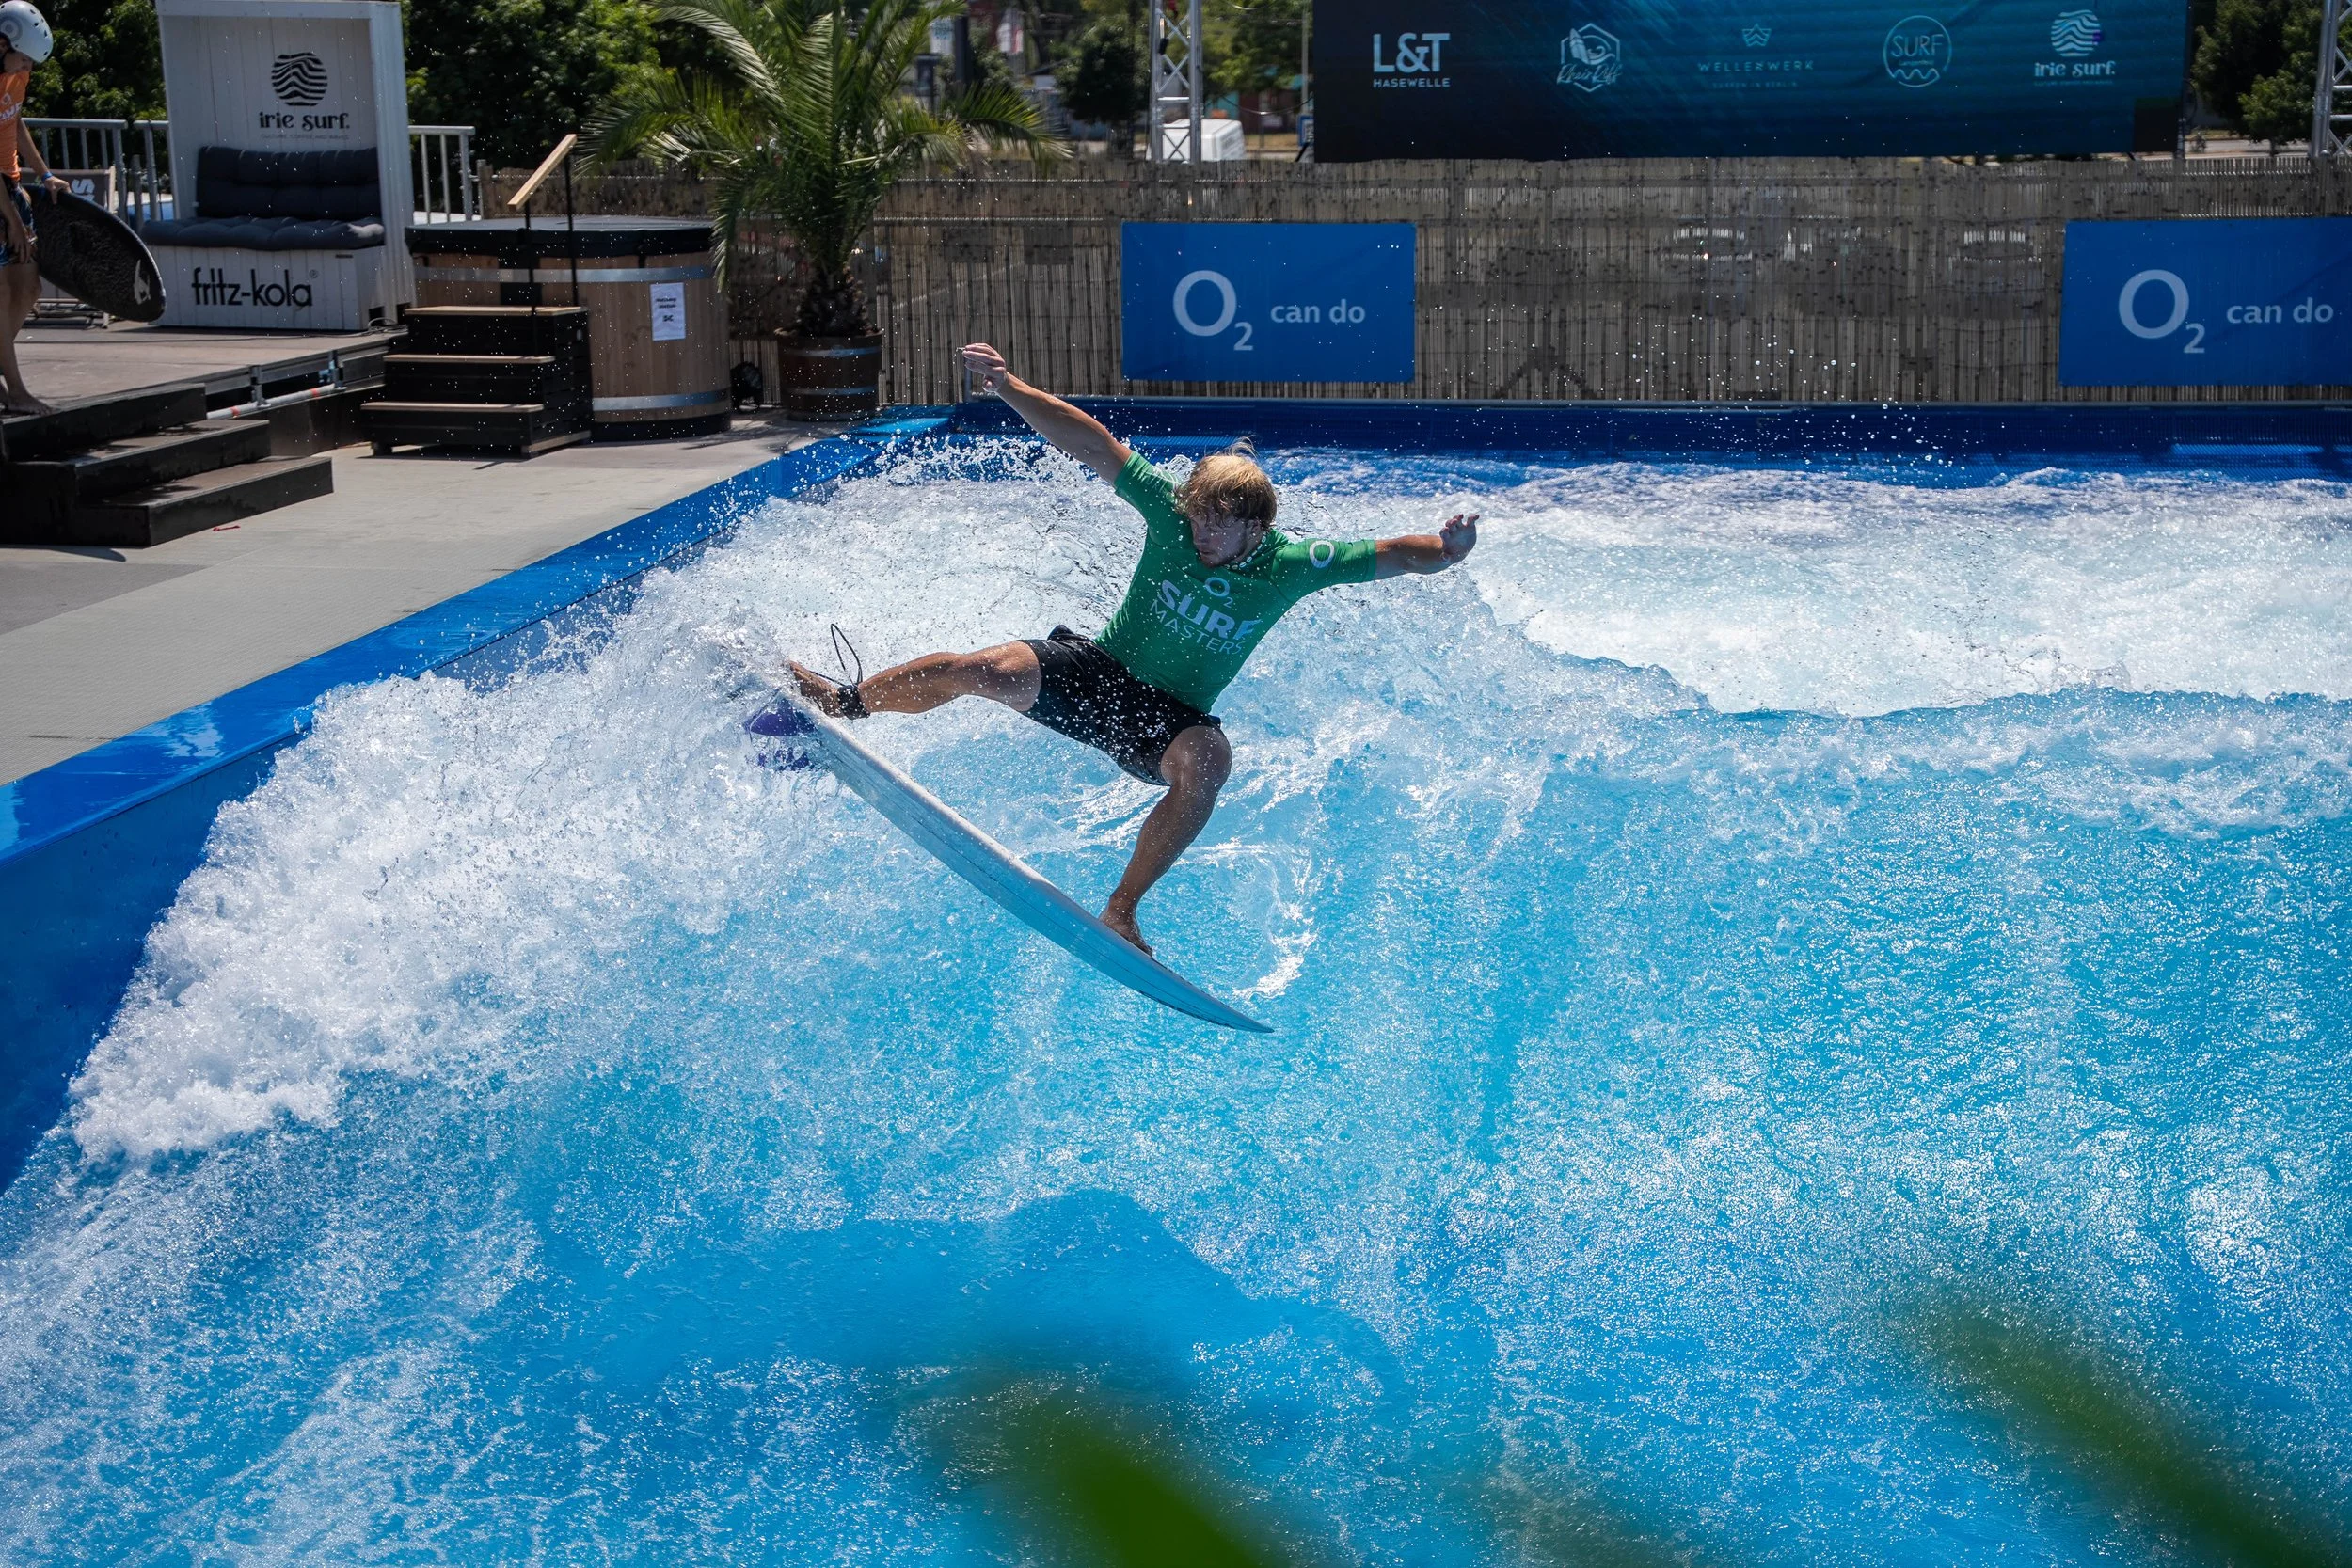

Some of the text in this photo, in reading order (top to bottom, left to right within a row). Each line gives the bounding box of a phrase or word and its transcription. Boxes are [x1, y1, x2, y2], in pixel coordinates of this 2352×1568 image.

[1373, 32, 1451, 73] L&T
[1891, 34, 1944, 57] SURF
[1697, 60, 1814, 72] WELLENWERK
[2034, 62, 2067, 77] irie
[1373, 78, 1451, 88] HASEWELLE
[259, 112, 294, 129] irie
[191, 267, 313, 307] fritz-kola
[1270, 304, 1321, 323] can
[1328, 298, 1366, 324] do
[2226, 304, 2282, 324] can
[2293, 297, 2334, 324] do
[1157, 579, 1263, 641] SURF
[1149, 599, 1247, 655] MASTERS
